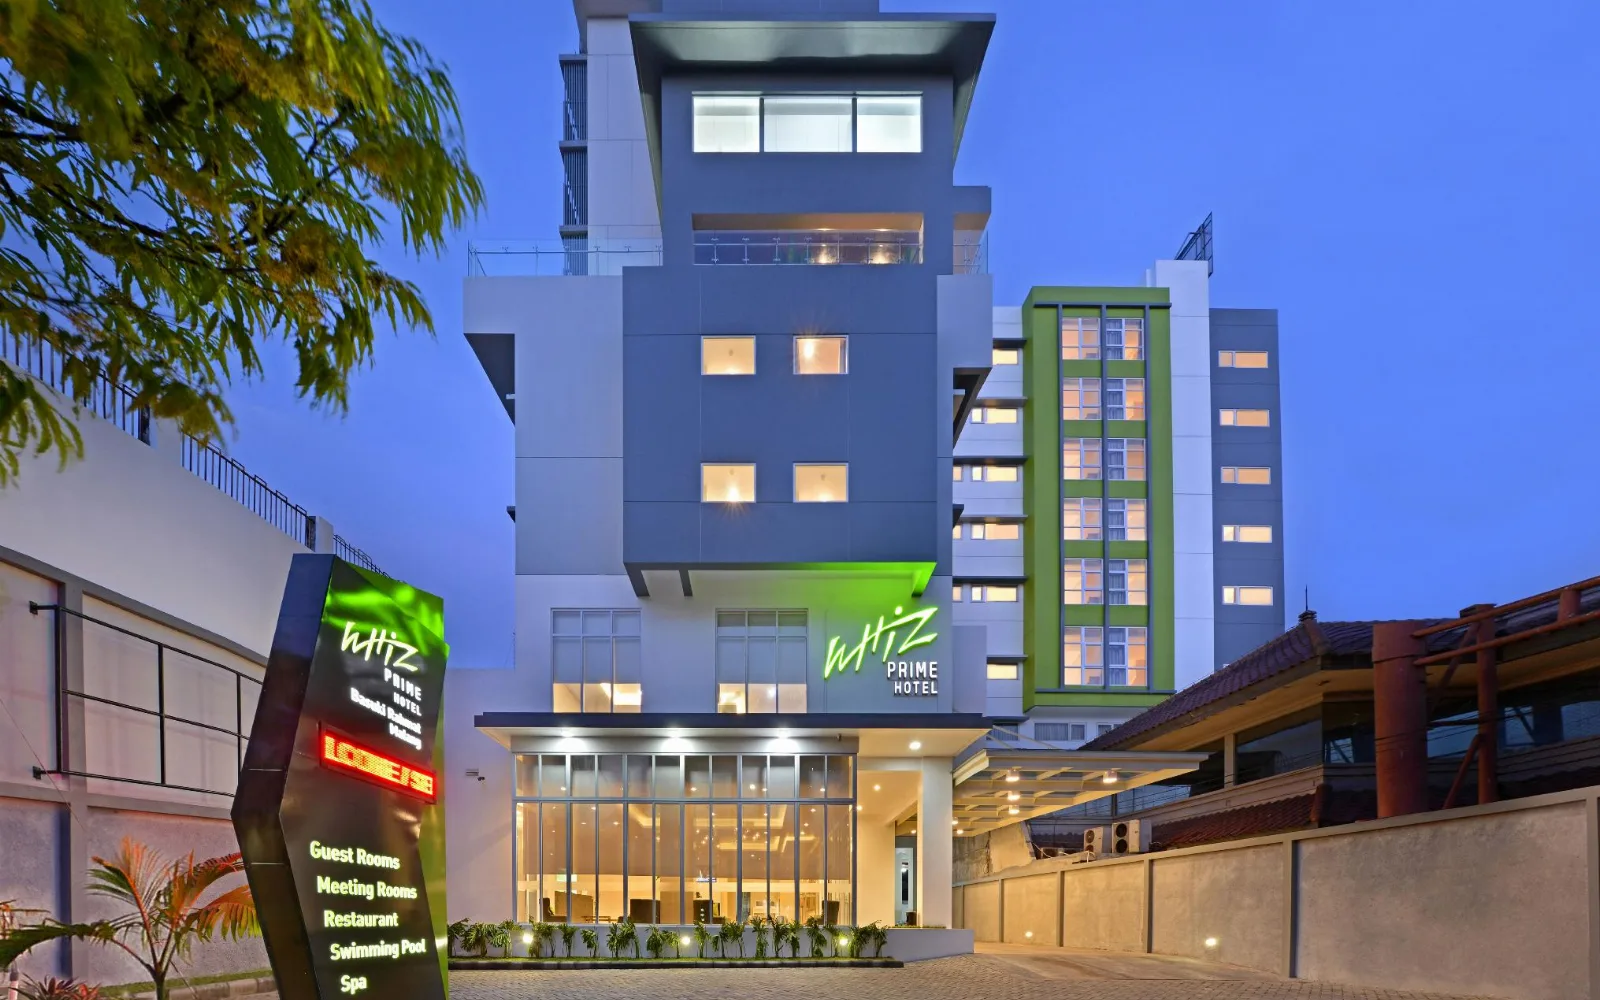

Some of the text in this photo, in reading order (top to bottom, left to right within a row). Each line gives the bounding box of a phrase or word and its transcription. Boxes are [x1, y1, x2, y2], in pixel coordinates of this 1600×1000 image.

[887, 661, 938, 678] PRIME
[384, 667, 421, 701] PRIME
[894, 680, 938, 694] HOTEL
[393, 691, 422, 717] HOTEL
[309, 841, 401, 870] Guest Rooms
[317, 876, 418, 900] Meeting Rooms
[323, 910, 399, 928] Restaurant
[330, 938, 427, 961] Swimming Pool
[340, 975, 368, 995] Spa
